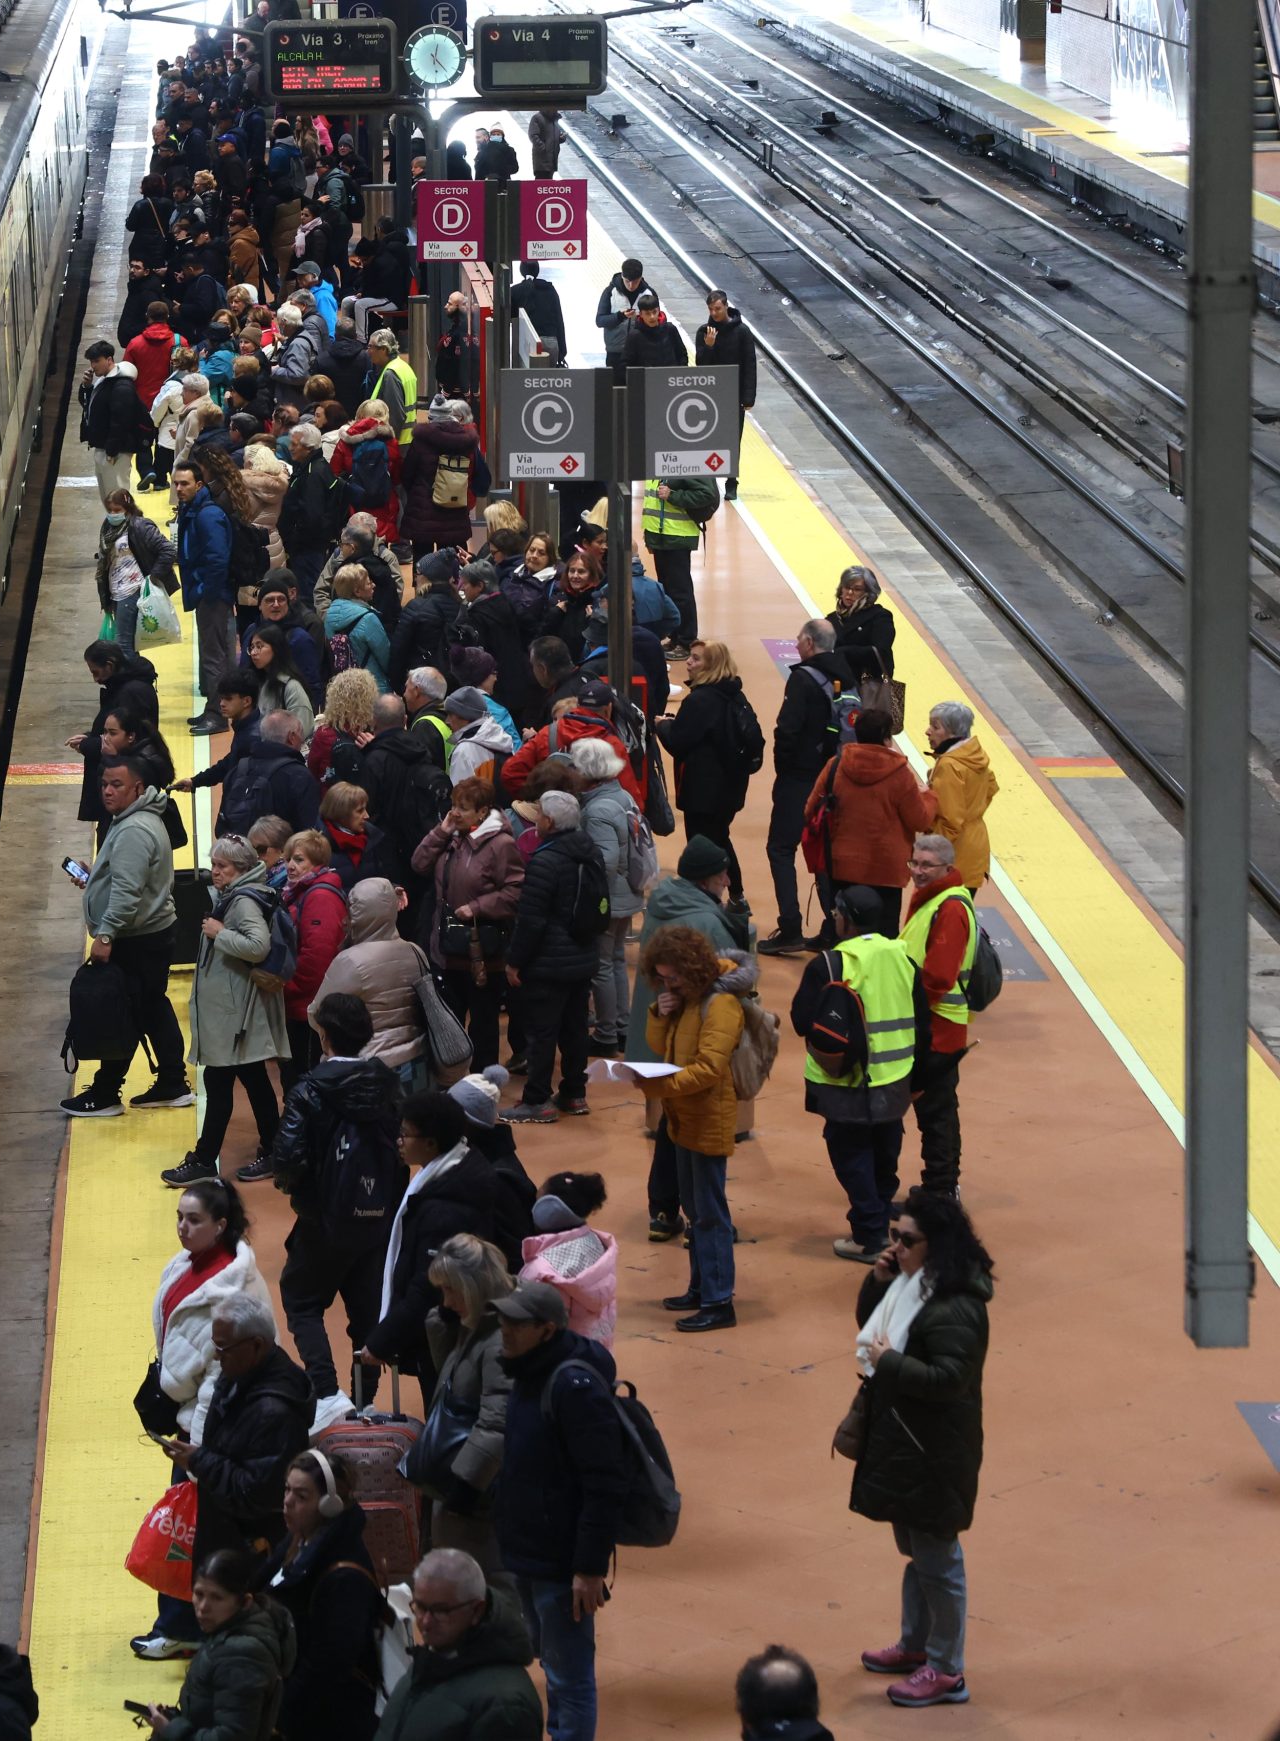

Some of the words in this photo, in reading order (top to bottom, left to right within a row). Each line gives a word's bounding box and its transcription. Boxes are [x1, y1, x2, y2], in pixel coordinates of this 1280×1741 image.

[437, 6, 450, 24] E
[301, 32, 324, 46] Vía
[333, 33, 342, 45] 3
[541, 29, 550, 41] 4
[434, 187, 469, 195] SECTOR
[537, 186, 572, 194] SECTOR
[442, 204, 464, 229] D
[545, 203, 567, 228] D
[428, 250, 456, 258] Platform
[463, 245, 469, 255] 3
[532, 250, 560, 258] Platform
[567, 245, 573, 254] 4
[524, 378, 572, 388] SECTOR
[668, 376, 716, 386] SECTOR
[532, 400, 563, 436] C
[677, 398, 707, 434] C
[565, 459, 574, 471] 3
[710, 456, 718, 468] 4
[516, 465, 555, 476] Platform
[661, 464, 700, 475] Platform
